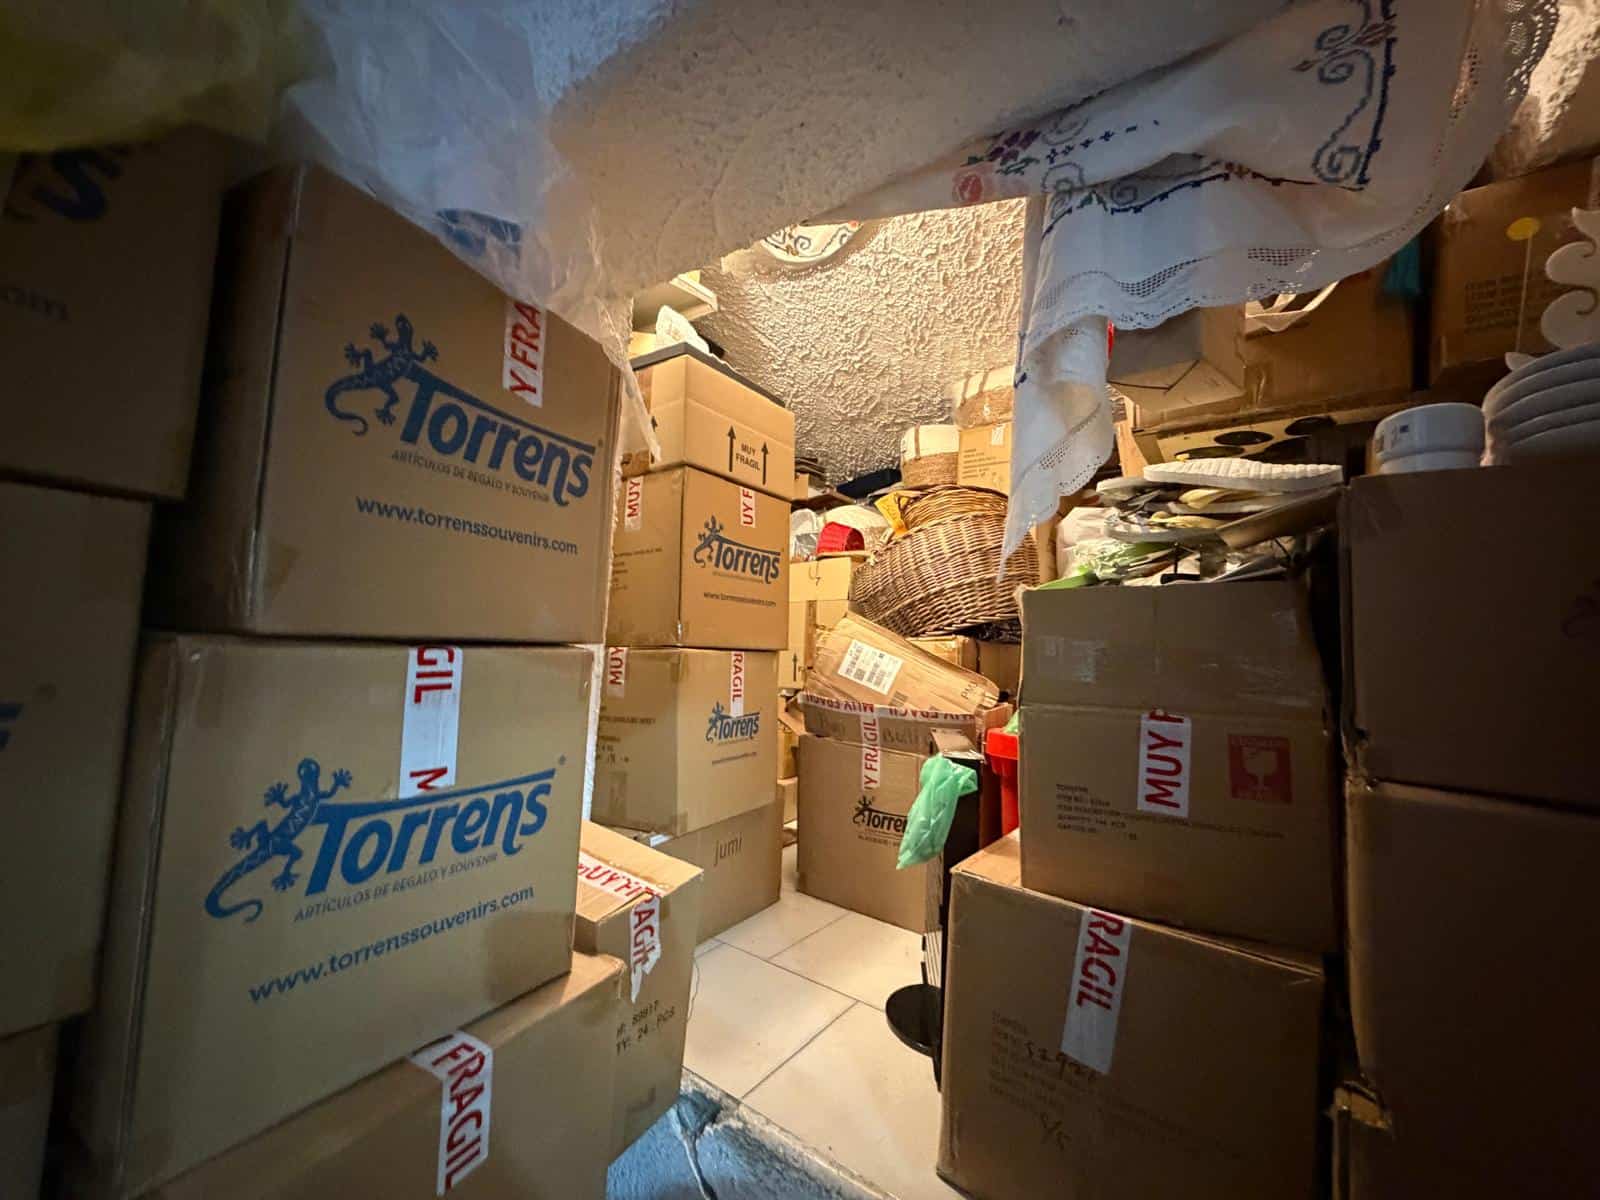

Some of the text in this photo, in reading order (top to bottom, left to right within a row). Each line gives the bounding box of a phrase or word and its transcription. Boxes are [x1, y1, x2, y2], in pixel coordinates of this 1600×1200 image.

[509, 370, 537, 395] Y
[401, 360, 597, 507] Torrens
[740, 443, 756, 457] MUY
[452, 466, 466, 479] DE
[735, 453, 761, 471] FRAGIL
[626, 480, 642, 518] MUY
[356, 495, 578, 555] www.torrenssouvenirs.com
[714, 534, 781, 585] Torrens
[413, 646, 455, 704] GIL
[609, 646, 625, 686] MUY
[732, 652, 744, 702] RAGIL
[718, 711, 761, 740] Torrens
[863, 718, 880, 772] FRAGIL
[1144, 730, 1184, 809] MUY
[304, 768, 557, 898] Torrens
[865, 806, 908, 833] Torre
[374, 883, 388, 899] DE
[392, 870, 438, 893] REGALO
[249, 885, 535, 1003] www.torrenssouvenirs.com
[1076, 910, 1125, 1011] RAGIL
[431, 1042, 486, 1191] FRAGIL
